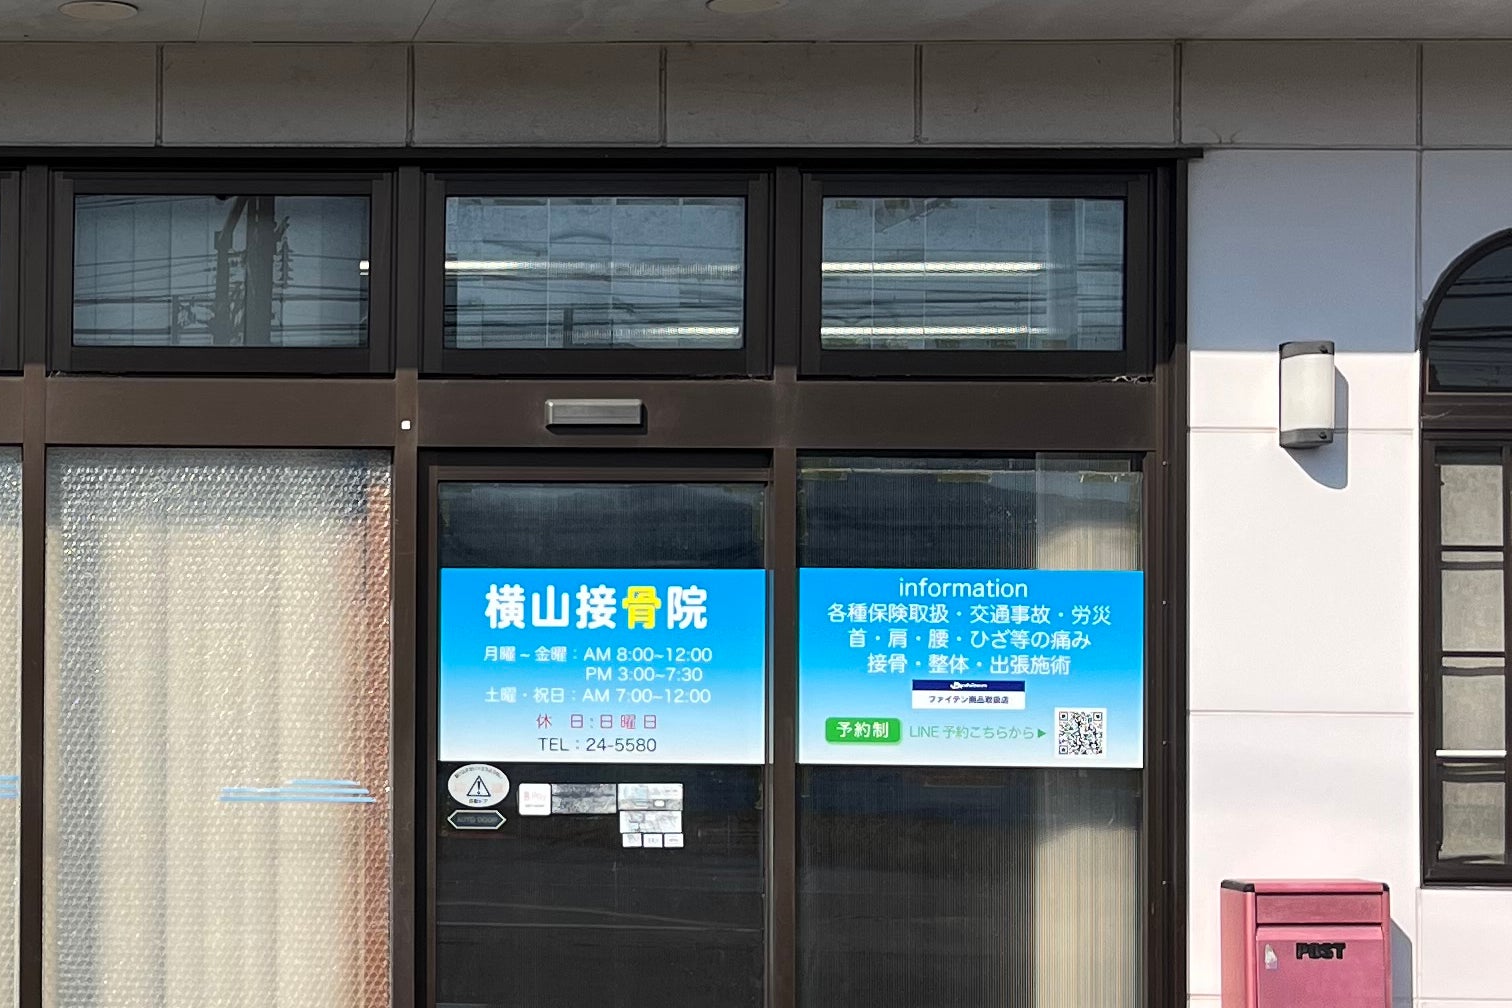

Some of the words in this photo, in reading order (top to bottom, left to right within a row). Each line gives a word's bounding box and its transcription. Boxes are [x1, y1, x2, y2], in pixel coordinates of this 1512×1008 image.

[899, 577, 1029, 598] information
[484, 583, 708, 630] 横山接骨院
[826, 603, 1112, 625] 各種保険取扱・交通事故・労災
[847, 629, 1092, 650] 首・肩・腰・ひざ等の痛み
[585, 667, 612, 681] PM
[867, 653, 1071, 676] 接骨・整体・出張施術
[836, 721, 889, 738] 予約制
[1296, 942, 1346, 960] POST
